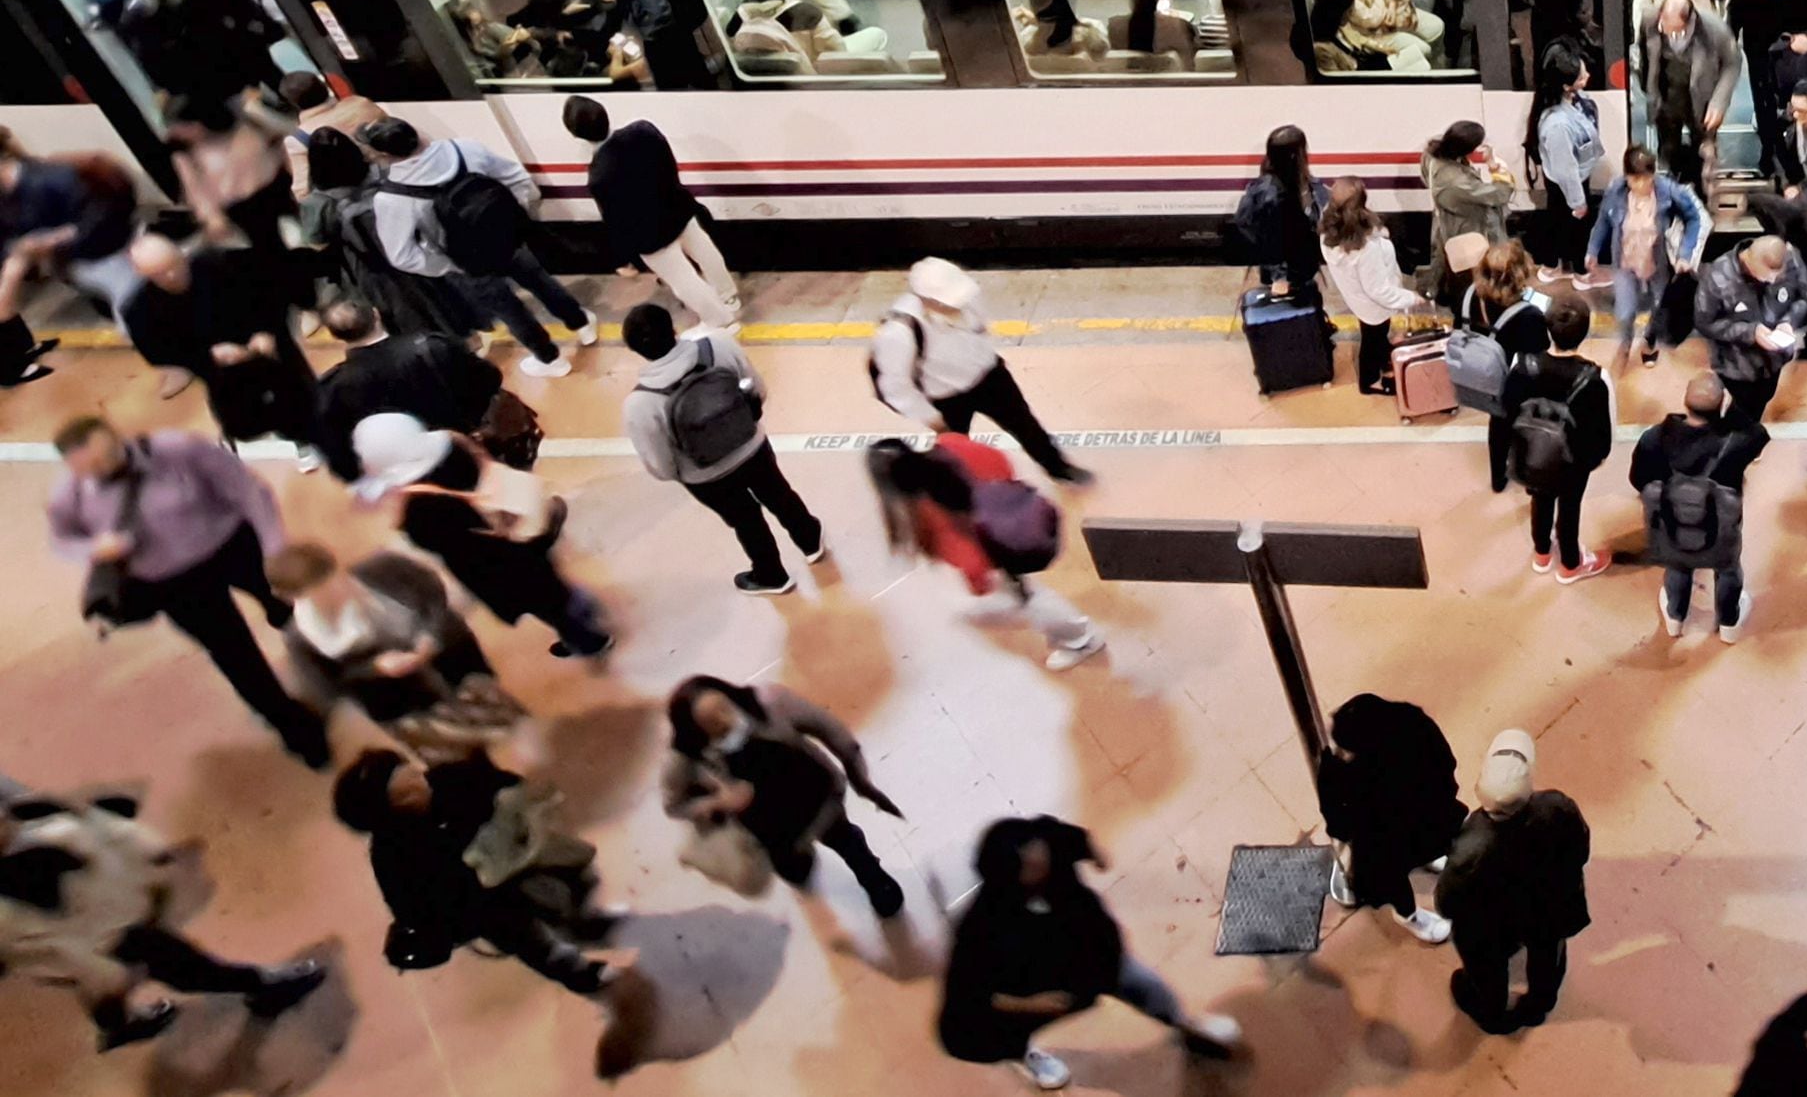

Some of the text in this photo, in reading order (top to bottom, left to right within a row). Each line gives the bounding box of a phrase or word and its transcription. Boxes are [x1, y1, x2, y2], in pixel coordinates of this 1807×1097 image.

[804, 435, 850, 450] KEEP
[1084, 432, 1136, 447] DETRAS
[1140, 432, 1158, 445] DE
[1161, 431, 1179, 445] LA
[1182, 429, 1222, 444] LINEA
